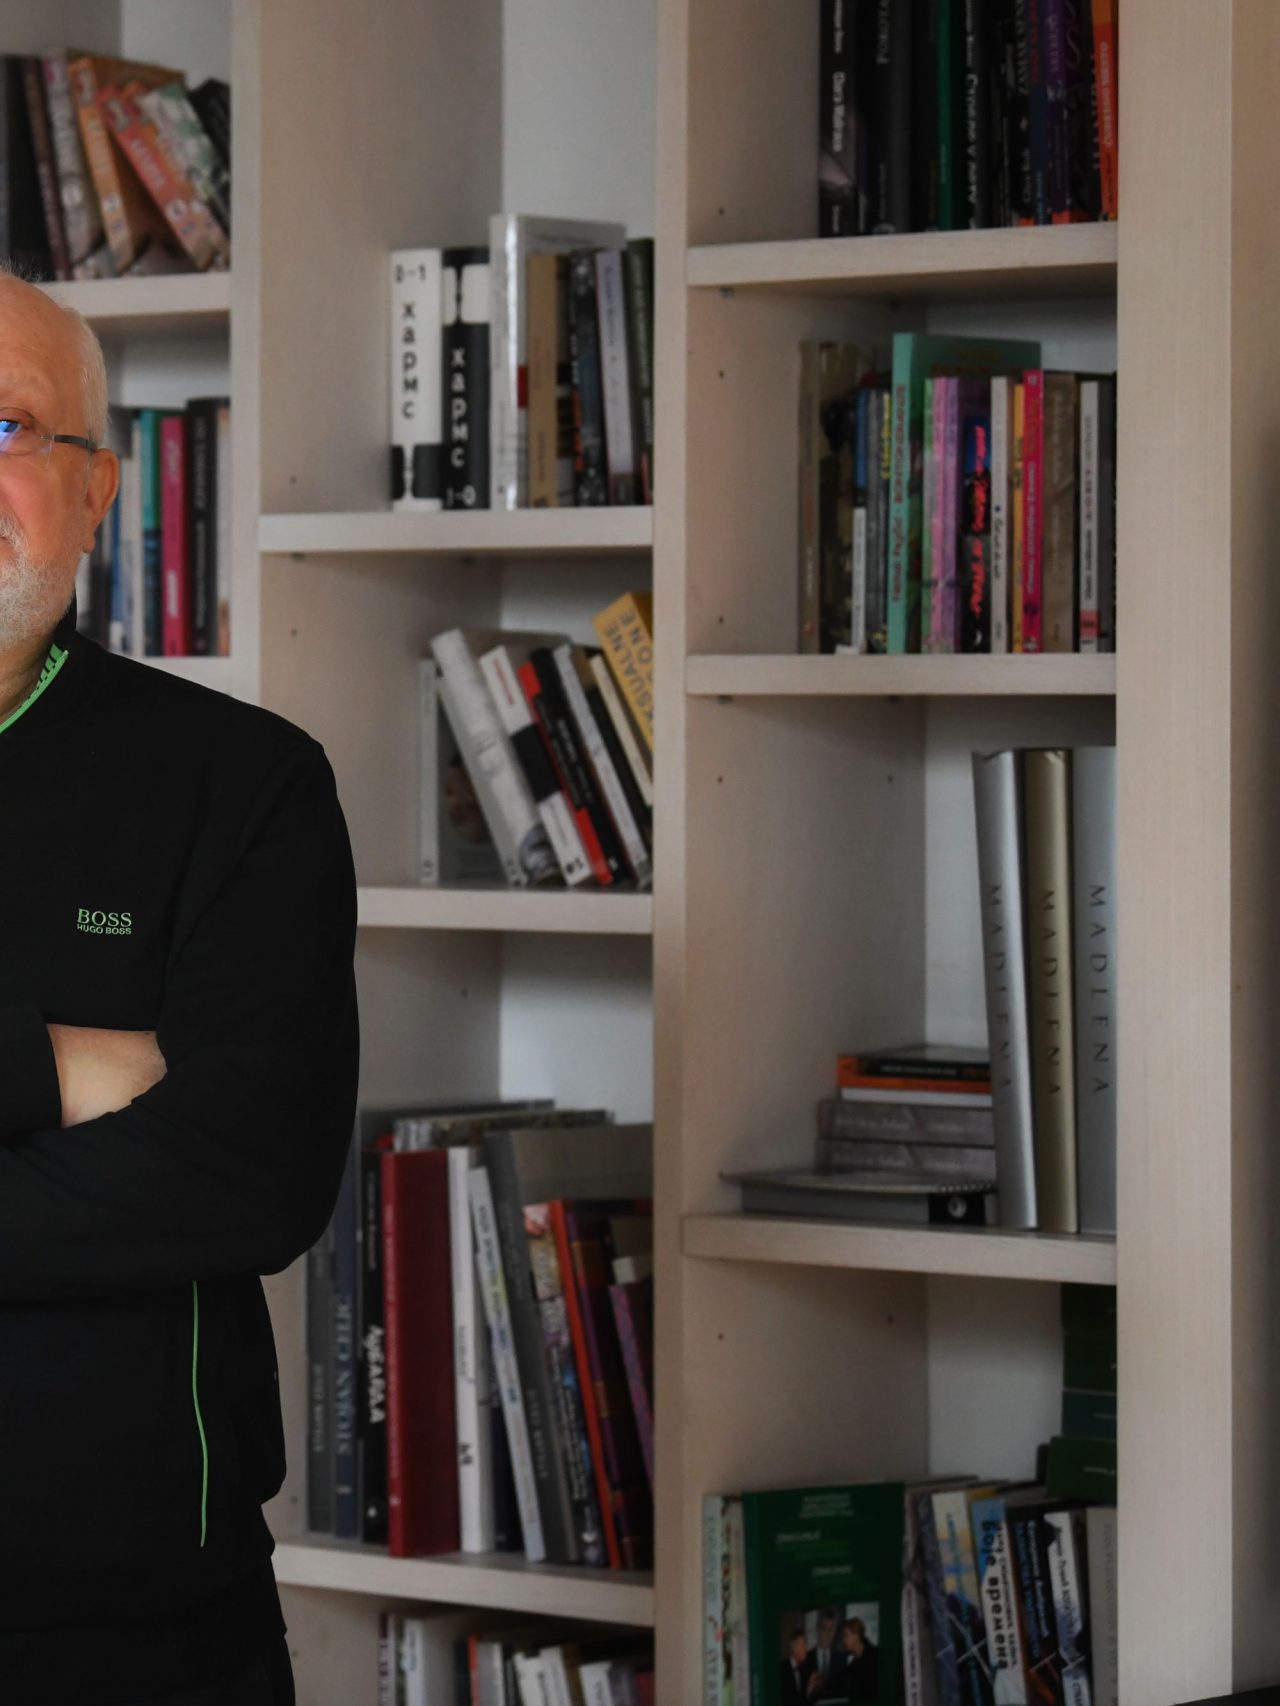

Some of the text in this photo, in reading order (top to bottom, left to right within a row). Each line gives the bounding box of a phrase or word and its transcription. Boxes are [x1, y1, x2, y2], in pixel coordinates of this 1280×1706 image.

[401, 302, 419, 419] хармс
[451, 348, 469, 467] хармс
[76, 924, 132, 935] HUGO BOSS
[77, 908, 132, 927] BOSS
[986, 884, 1012, 1089] MADLENA
[1039, 888, 1061, 1097] MADLENA
[1088, 884, 1110, 1096] MADLENA
[984, 1576, 1008, 1670] времена
